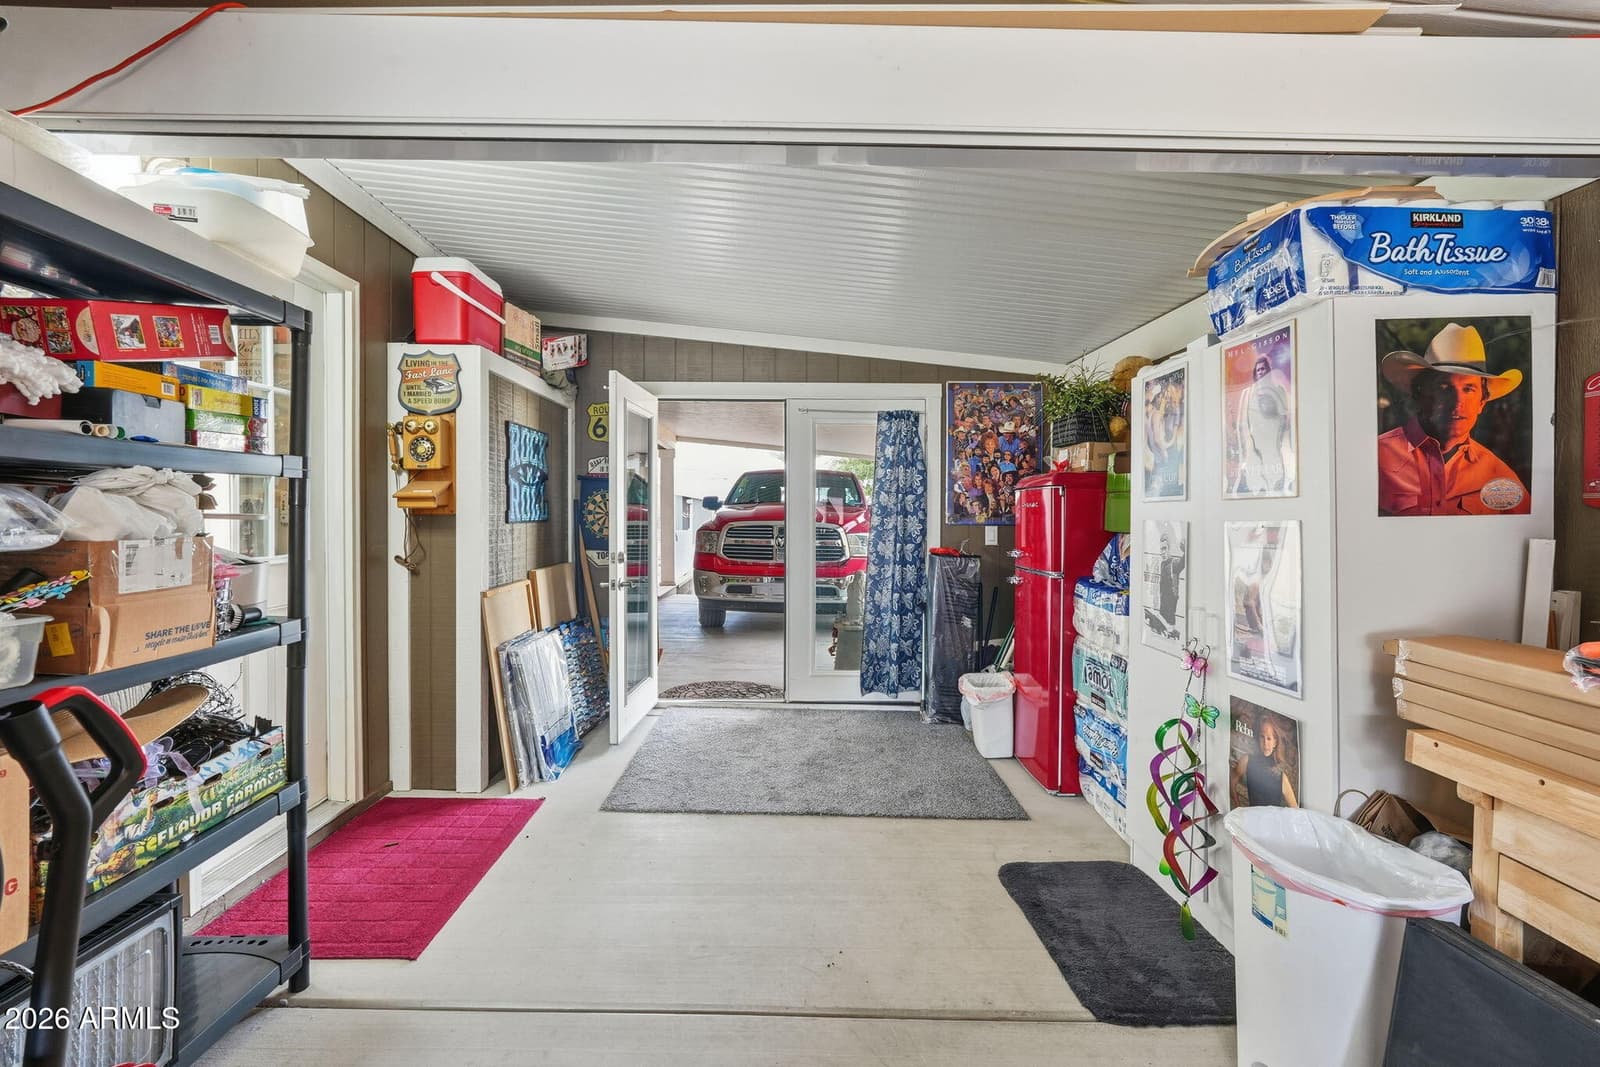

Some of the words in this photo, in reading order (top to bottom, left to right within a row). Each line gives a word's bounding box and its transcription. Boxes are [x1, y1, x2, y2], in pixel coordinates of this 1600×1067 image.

[1412, 213, 1461, 222] KIRKLAND
[1520, 216, 1534, 225] 30
[1369, 231, 1435, 264] Bath
[1433, 233, 1508, 265] Tissue
[1404, 268, 1418, 276] Soft
[405, 359, 430, 368] LIVING
[404, 370, 428, 380] Fast
[429, 367, 453, 377] Lane
[144, 628, 174, 641] SHARE
[174, 625, 191, 634] THE
[1235, 719, 1254, 737] Reba
